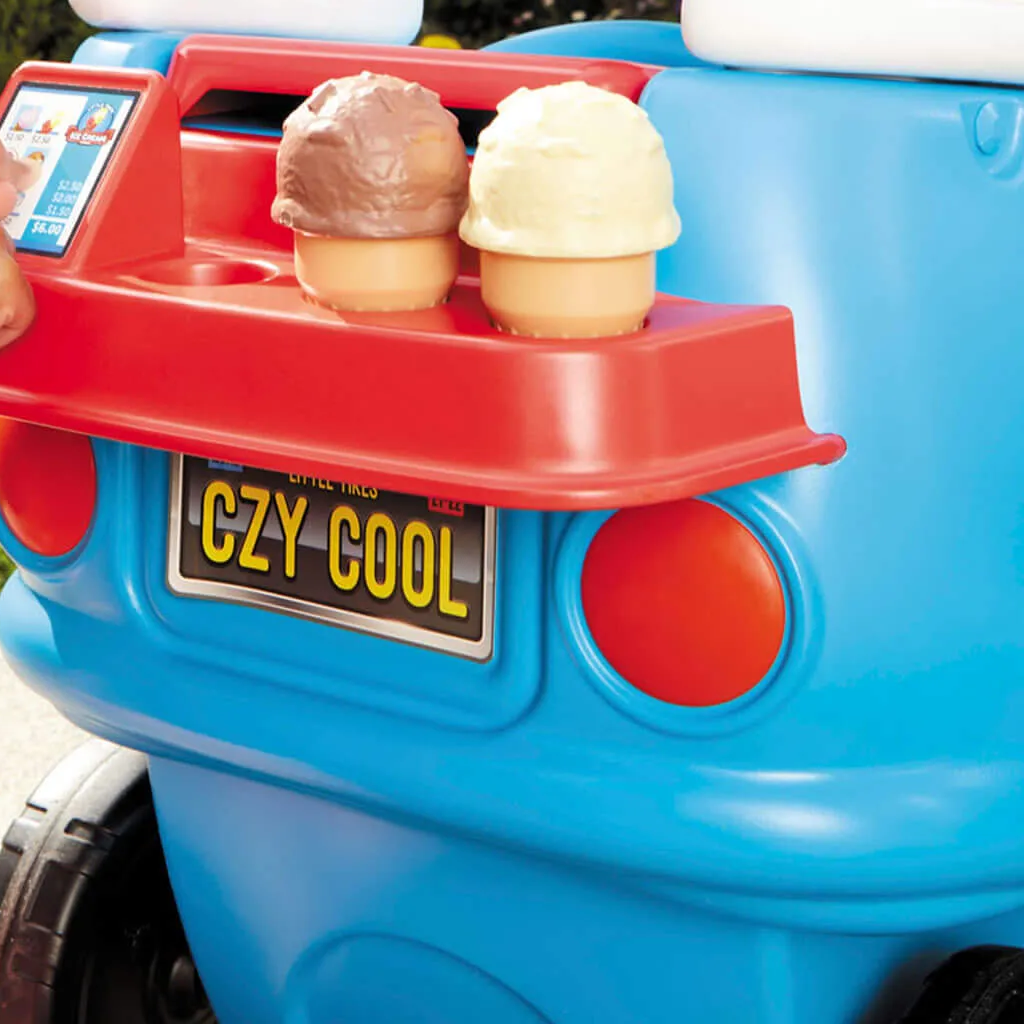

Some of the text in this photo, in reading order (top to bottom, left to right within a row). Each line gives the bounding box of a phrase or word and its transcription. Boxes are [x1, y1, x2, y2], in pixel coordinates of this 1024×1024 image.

[31, 221, 62, 236] $6.00
[201, 480, 468, 618] CZY COOL
